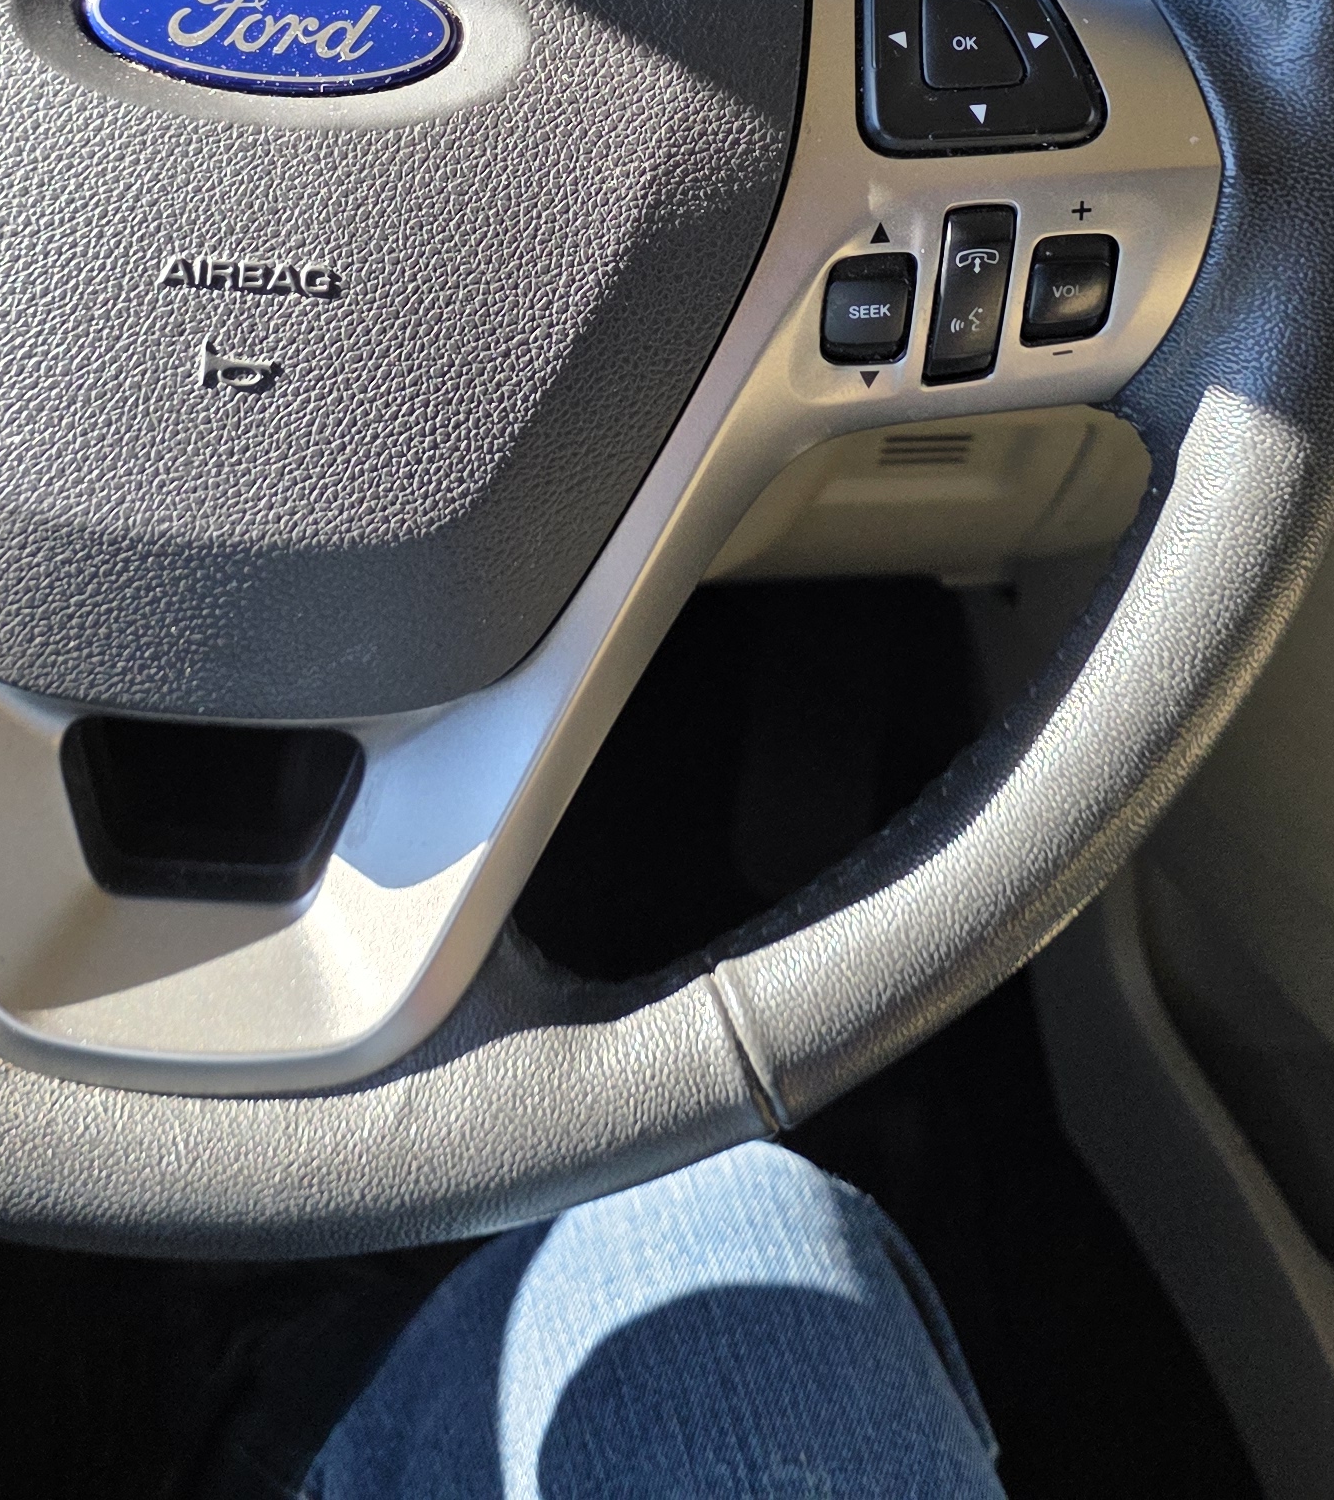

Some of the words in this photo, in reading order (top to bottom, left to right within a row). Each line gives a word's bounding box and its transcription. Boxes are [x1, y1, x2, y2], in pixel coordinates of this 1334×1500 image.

[952, 35, 979, 51] OK
[159, 256, 344, 298] AIRBAG
[848, 303, 892, 320] SEEK
